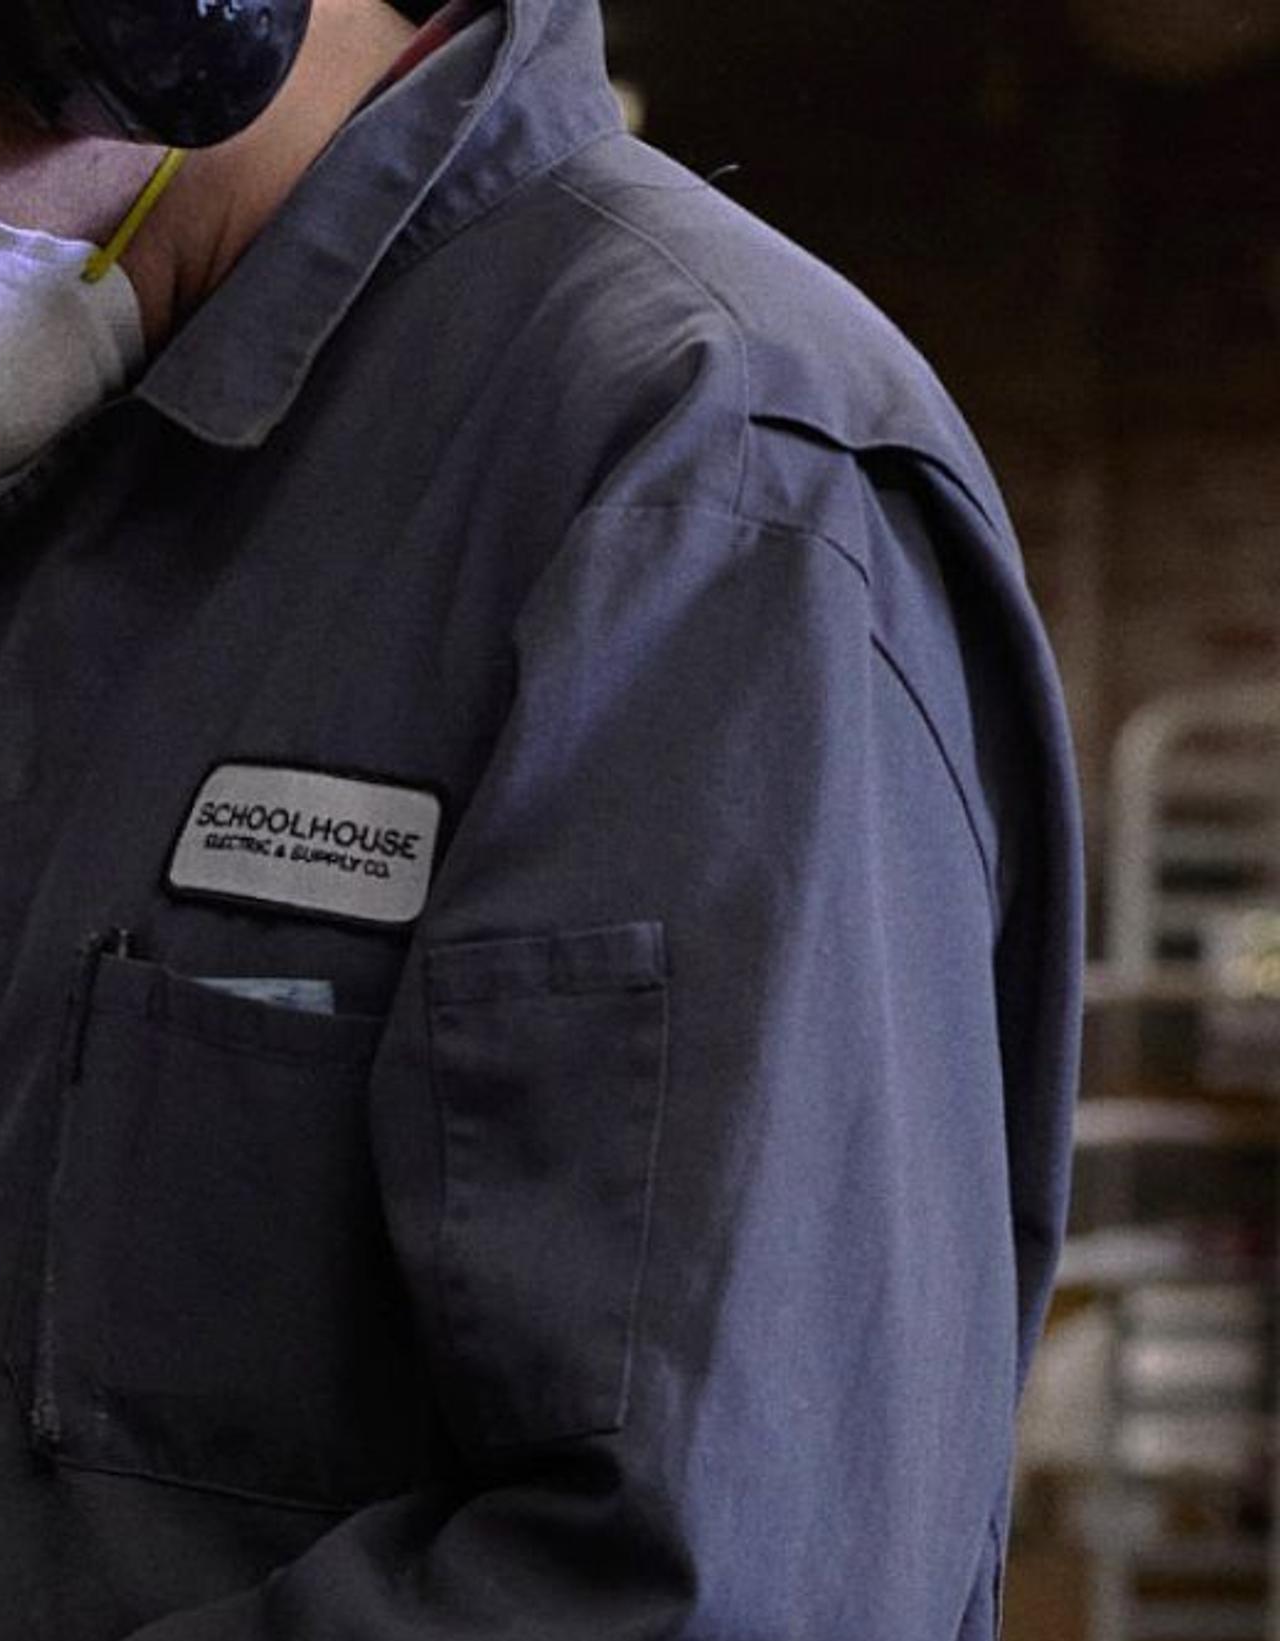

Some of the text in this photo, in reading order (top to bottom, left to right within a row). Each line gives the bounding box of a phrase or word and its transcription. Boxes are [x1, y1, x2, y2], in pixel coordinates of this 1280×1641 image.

[195, 801, 422, 860] SCHOOLHOUSE
[203, 833, 272, 856] ELECTRIC
[290, 844, 361, 871] SUPPLY
